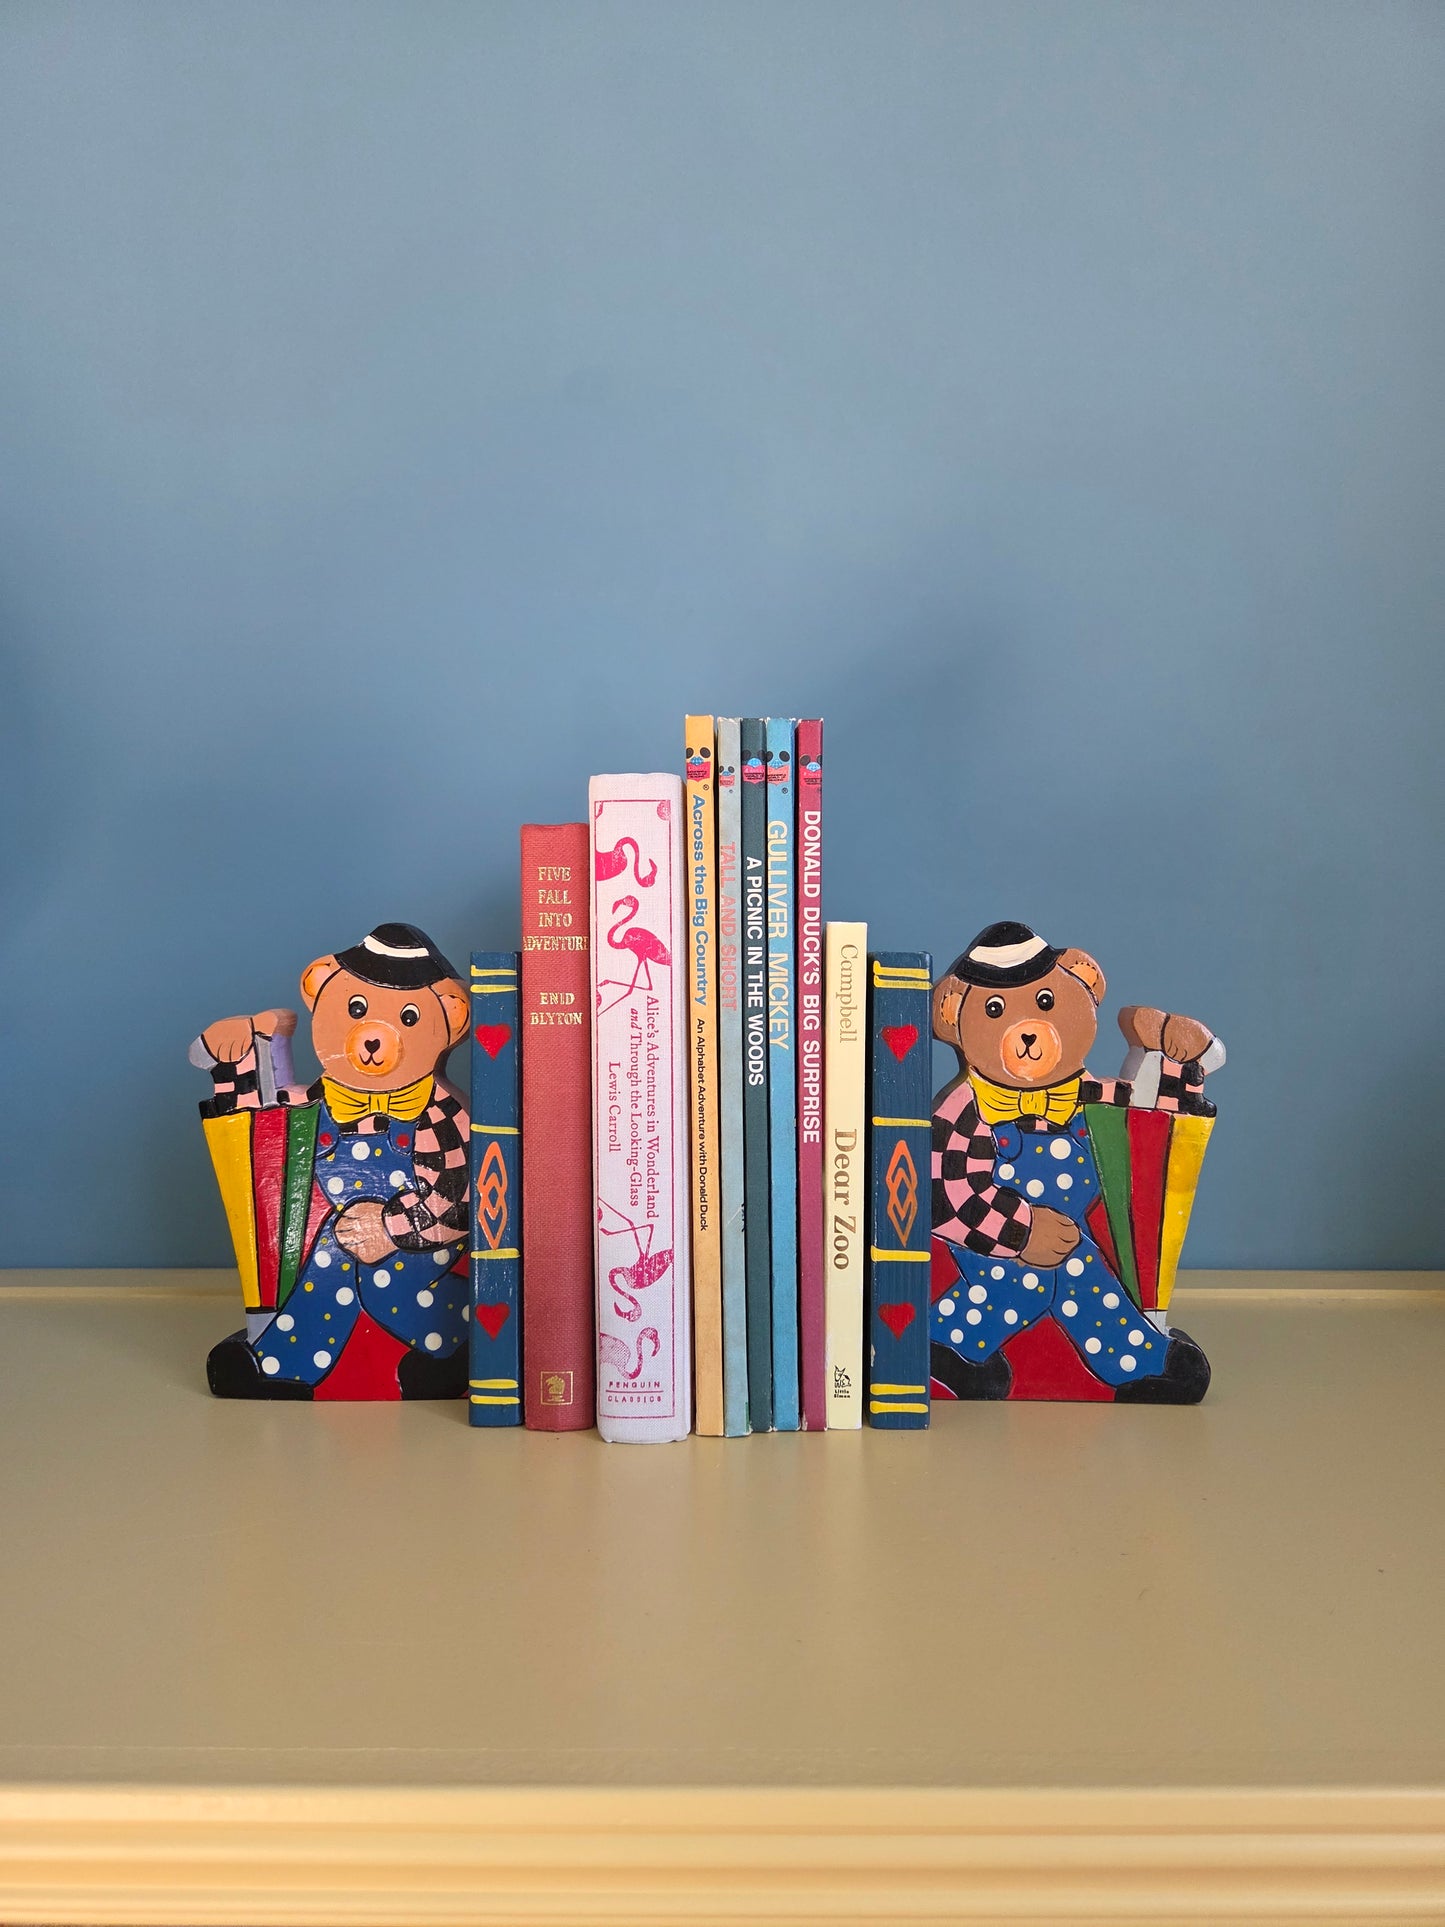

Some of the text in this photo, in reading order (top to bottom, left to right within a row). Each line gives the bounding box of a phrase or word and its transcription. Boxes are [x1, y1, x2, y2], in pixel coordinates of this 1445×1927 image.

[693, 794, 705, 861] Across
[538, 867, 571, 881] FIVE
[538, 890, 572, 904] FALL
[693, 898, 708, 926] Big
[695, 865, 707, 895] the
[538, 913, 573, 927] INTO
[721, 842, 736, 1011] TALL AND SHORT
[767, 820, 789, 1050] GULLIVER MICKEY
[539, 992, 575, 1005] ENID
[694, 930, 709, 1006] Country
[747, 856, 764, 1086] A PICNIC IN THE WOODS
[803, 811, 820, 1143] DONALD DUCK'S BIG SURPRISE
[836, 944, 858, 1043] Campbell
[530, 1012, 583, 1025] BLYTON
[609, 1061, 621, 1152] Lewis Carroll
[626, 1008, 643, 1207] and Through the Looking-Glass
[647, 995, 659, 1219] Alice's Adventures in Wonderland
[696, 1019, 708, 1231] An Alphabet Adventure with Donald Duck
[834, 1128, 857, 1270] Dear Zoo
[607, 1395, 662, 1403] CLASSICS
